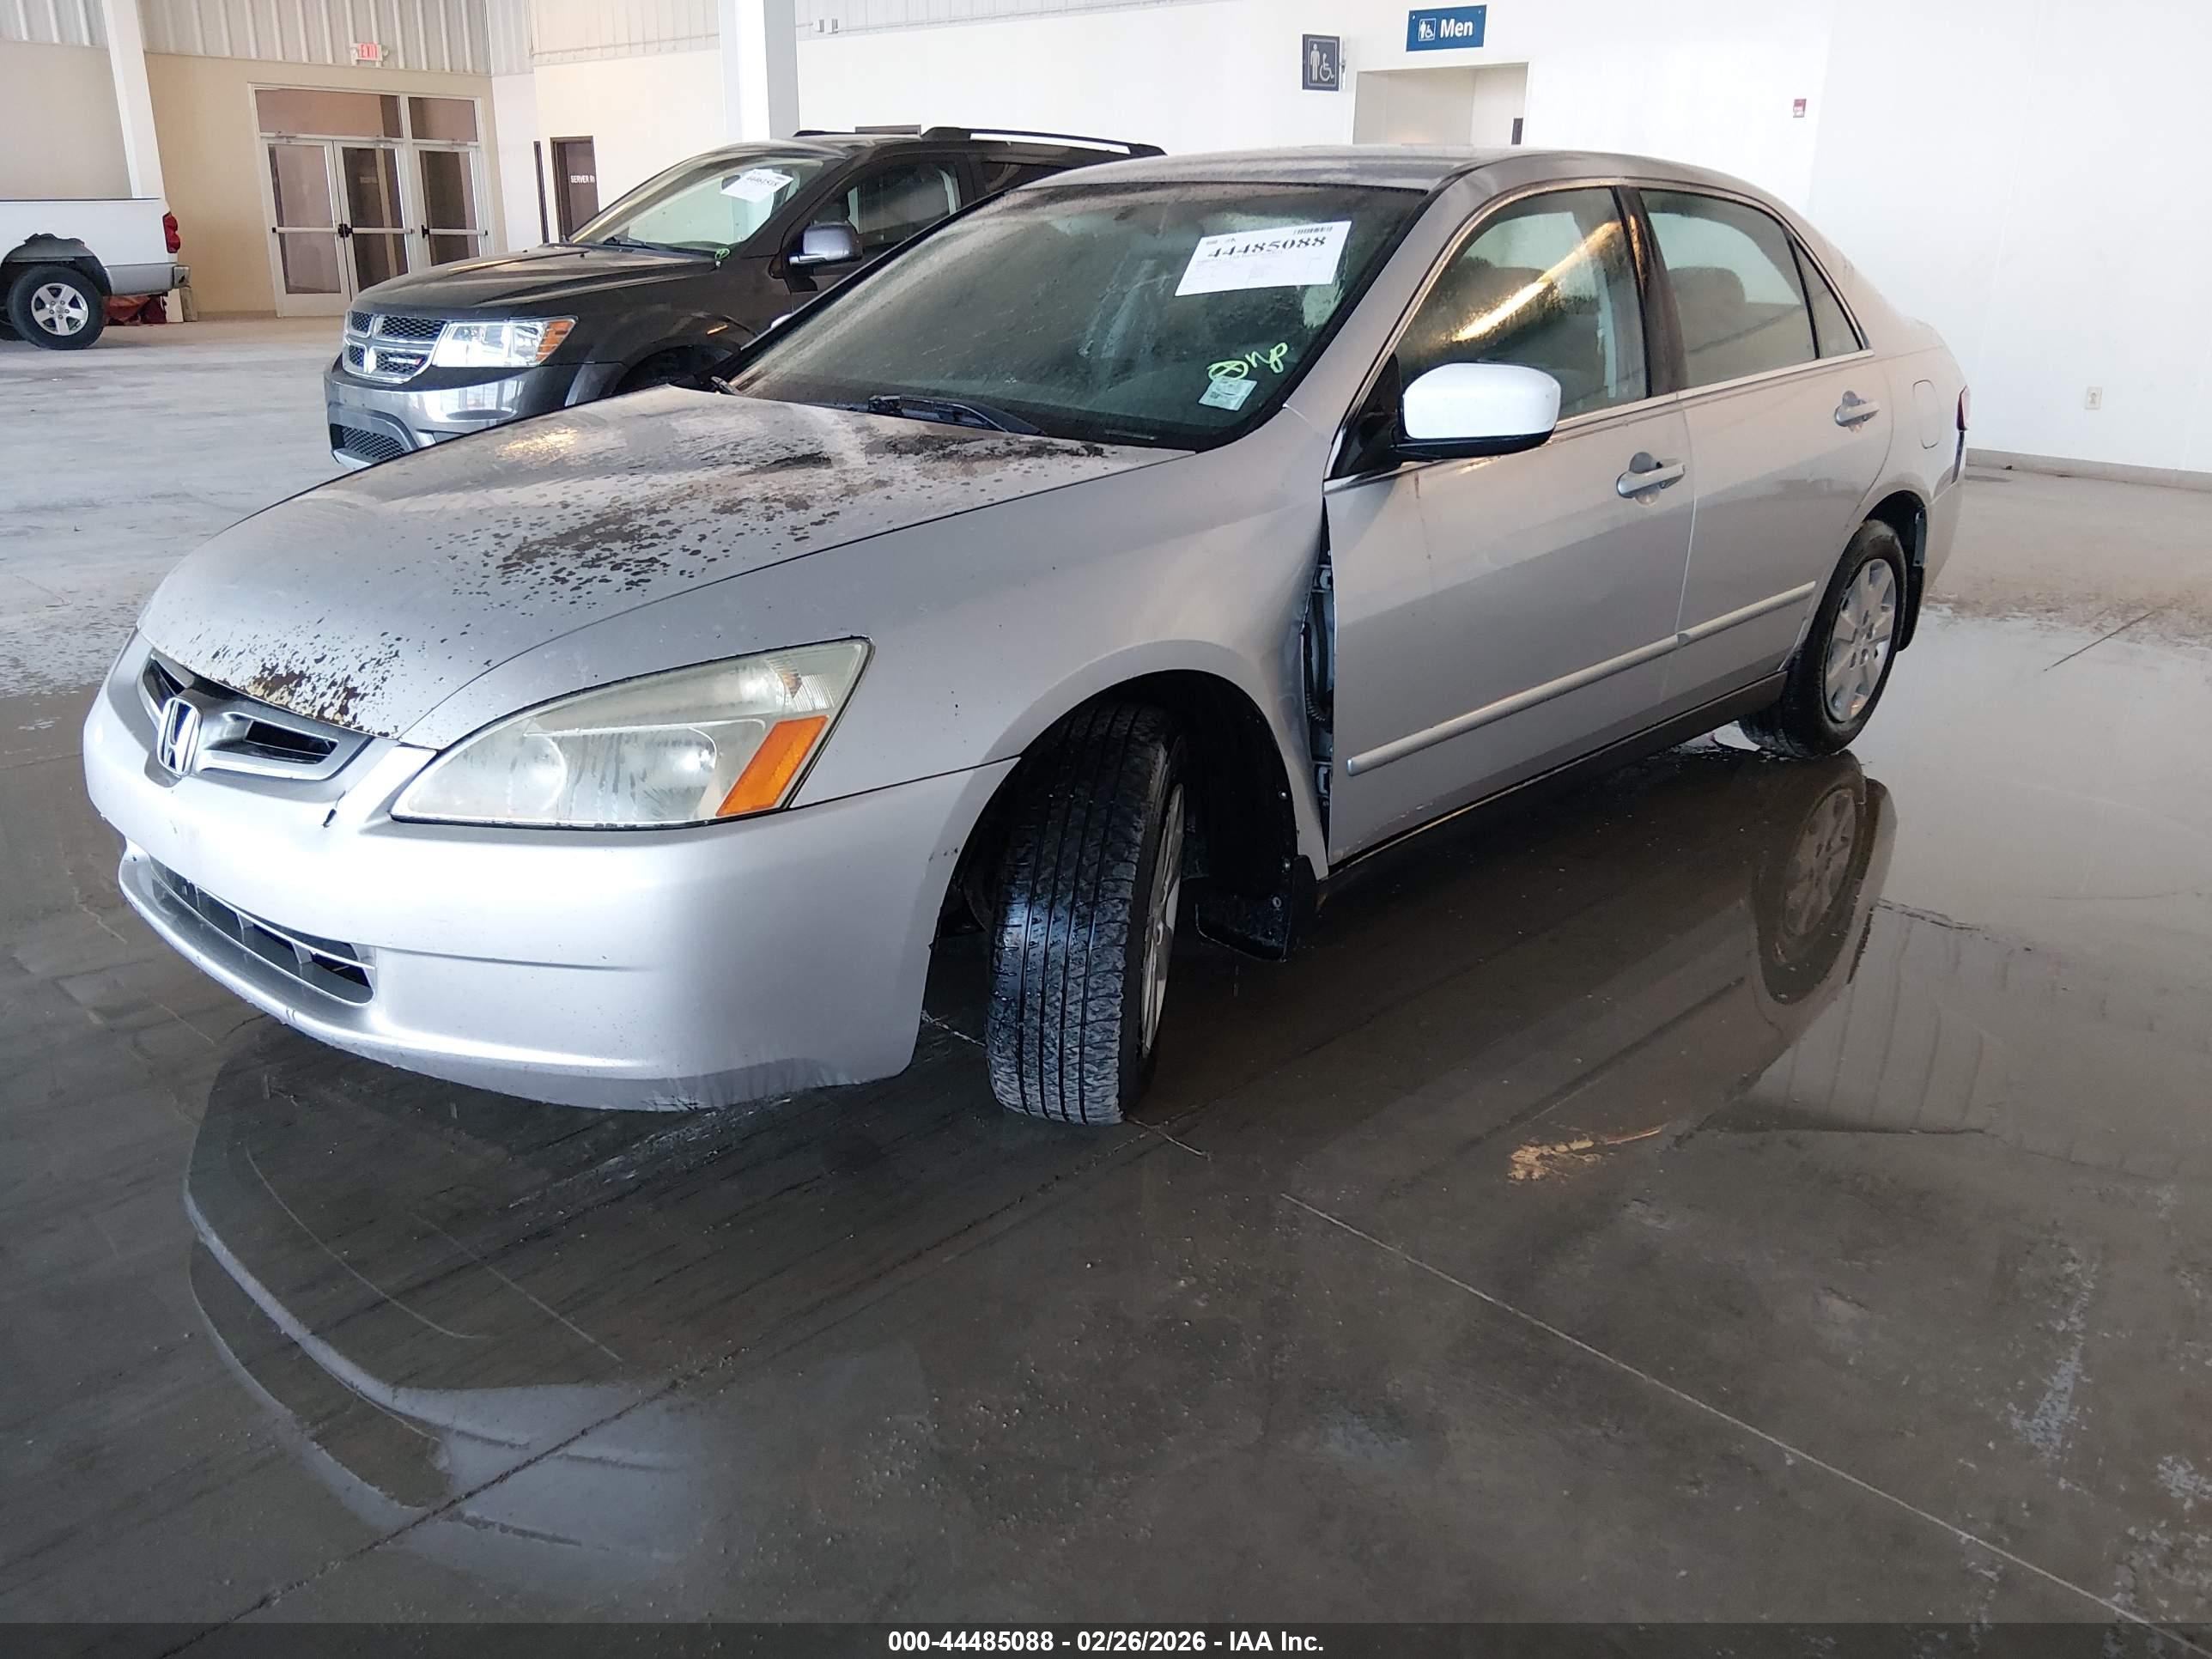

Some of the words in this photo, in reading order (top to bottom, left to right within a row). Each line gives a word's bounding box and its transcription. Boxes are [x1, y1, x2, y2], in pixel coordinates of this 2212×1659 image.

[1440, 19, 1474, 38] Men
[570, 174, 589, 184] SERVER
[1207, 236, 1326, 258] 44485088
